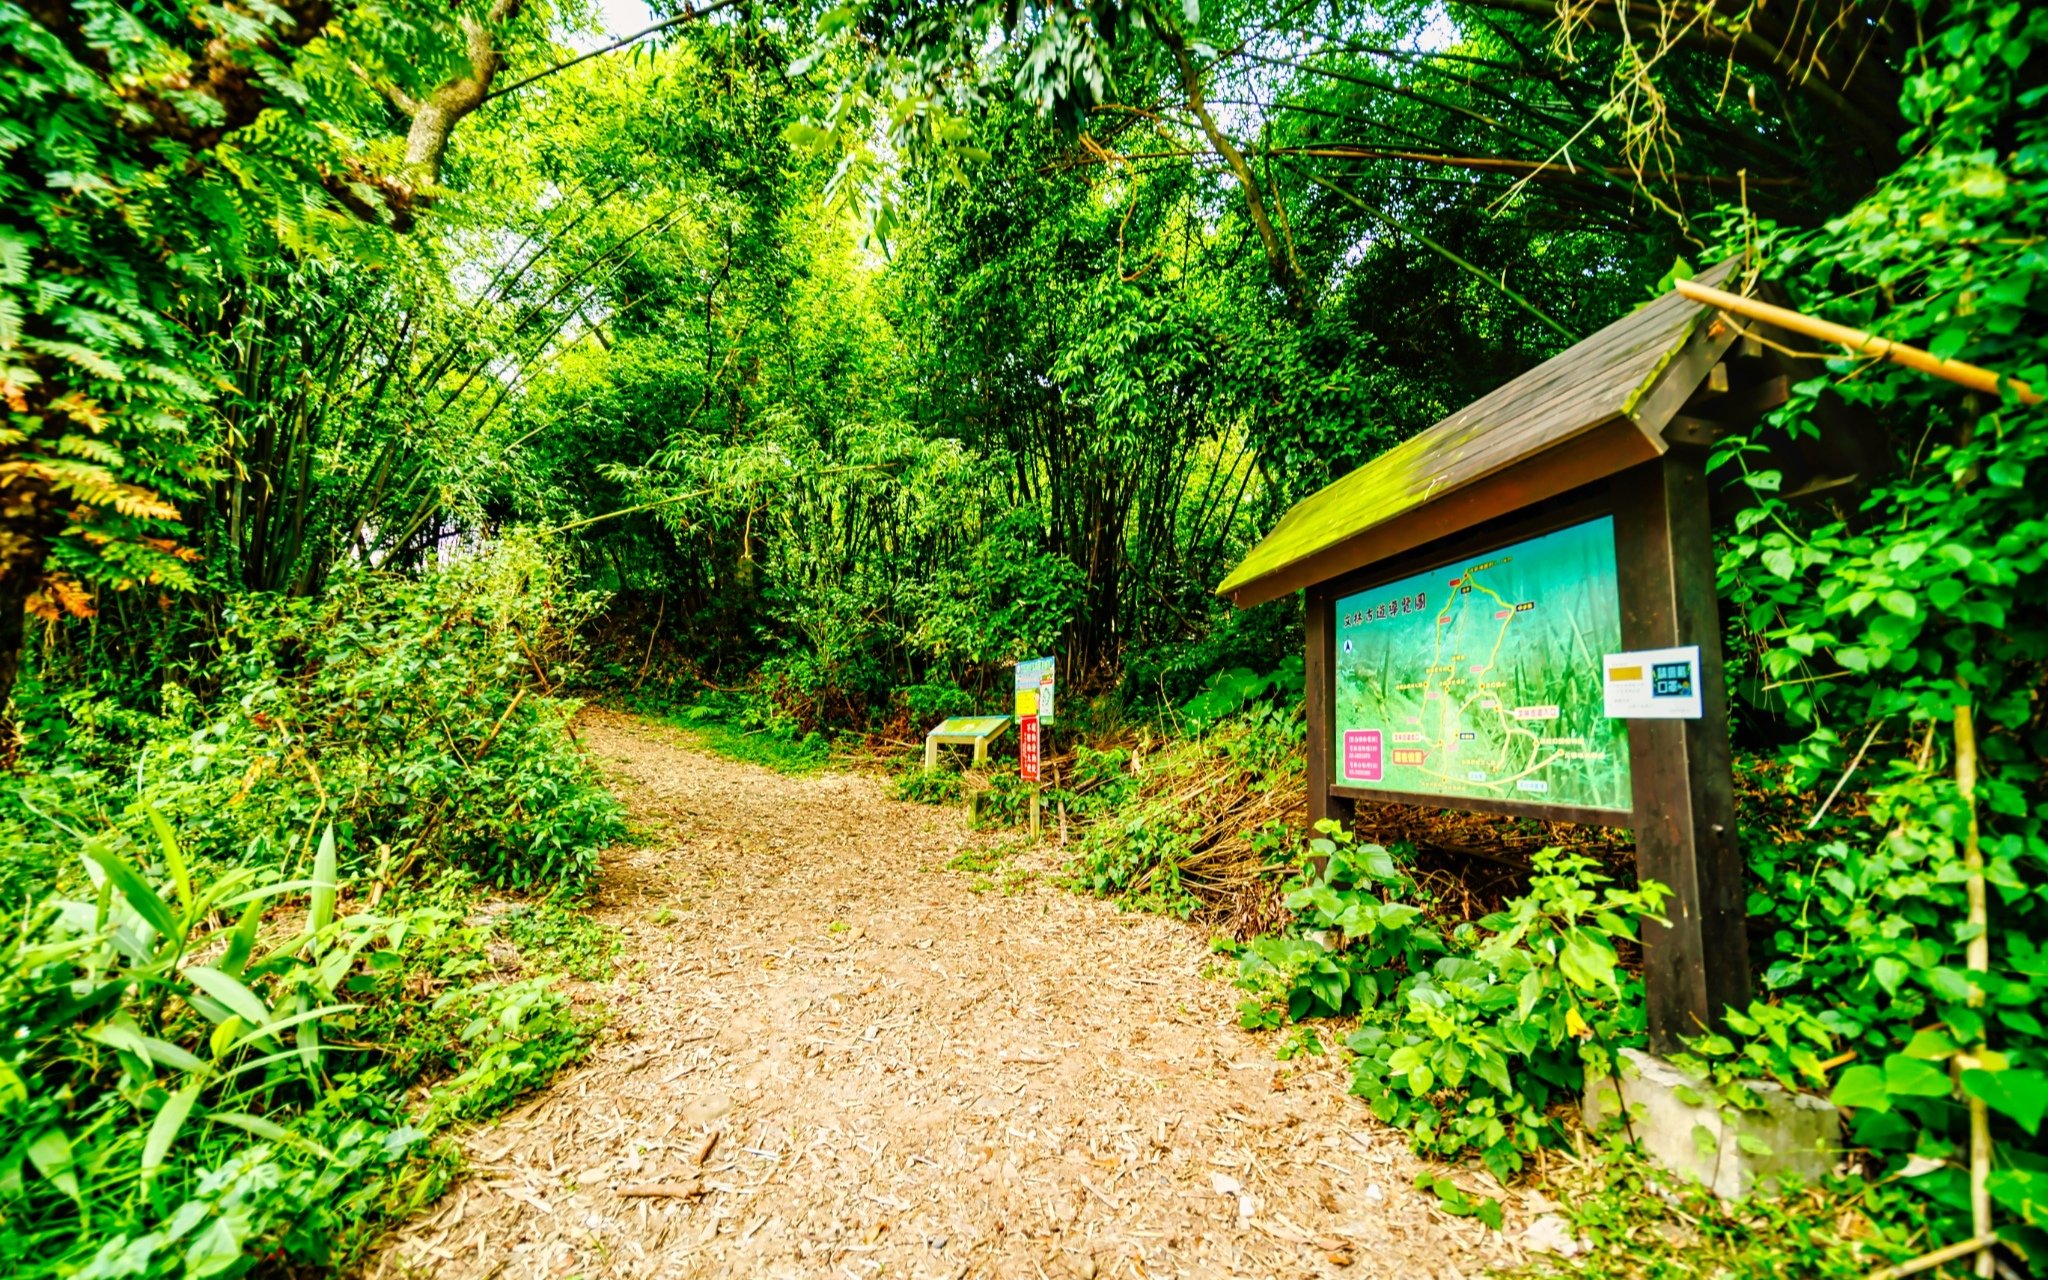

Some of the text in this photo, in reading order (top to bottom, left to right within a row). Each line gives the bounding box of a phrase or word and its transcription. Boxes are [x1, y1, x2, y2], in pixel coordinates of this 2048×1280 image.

[1344, 592, 1427, 628] 文林古道導覽圖
